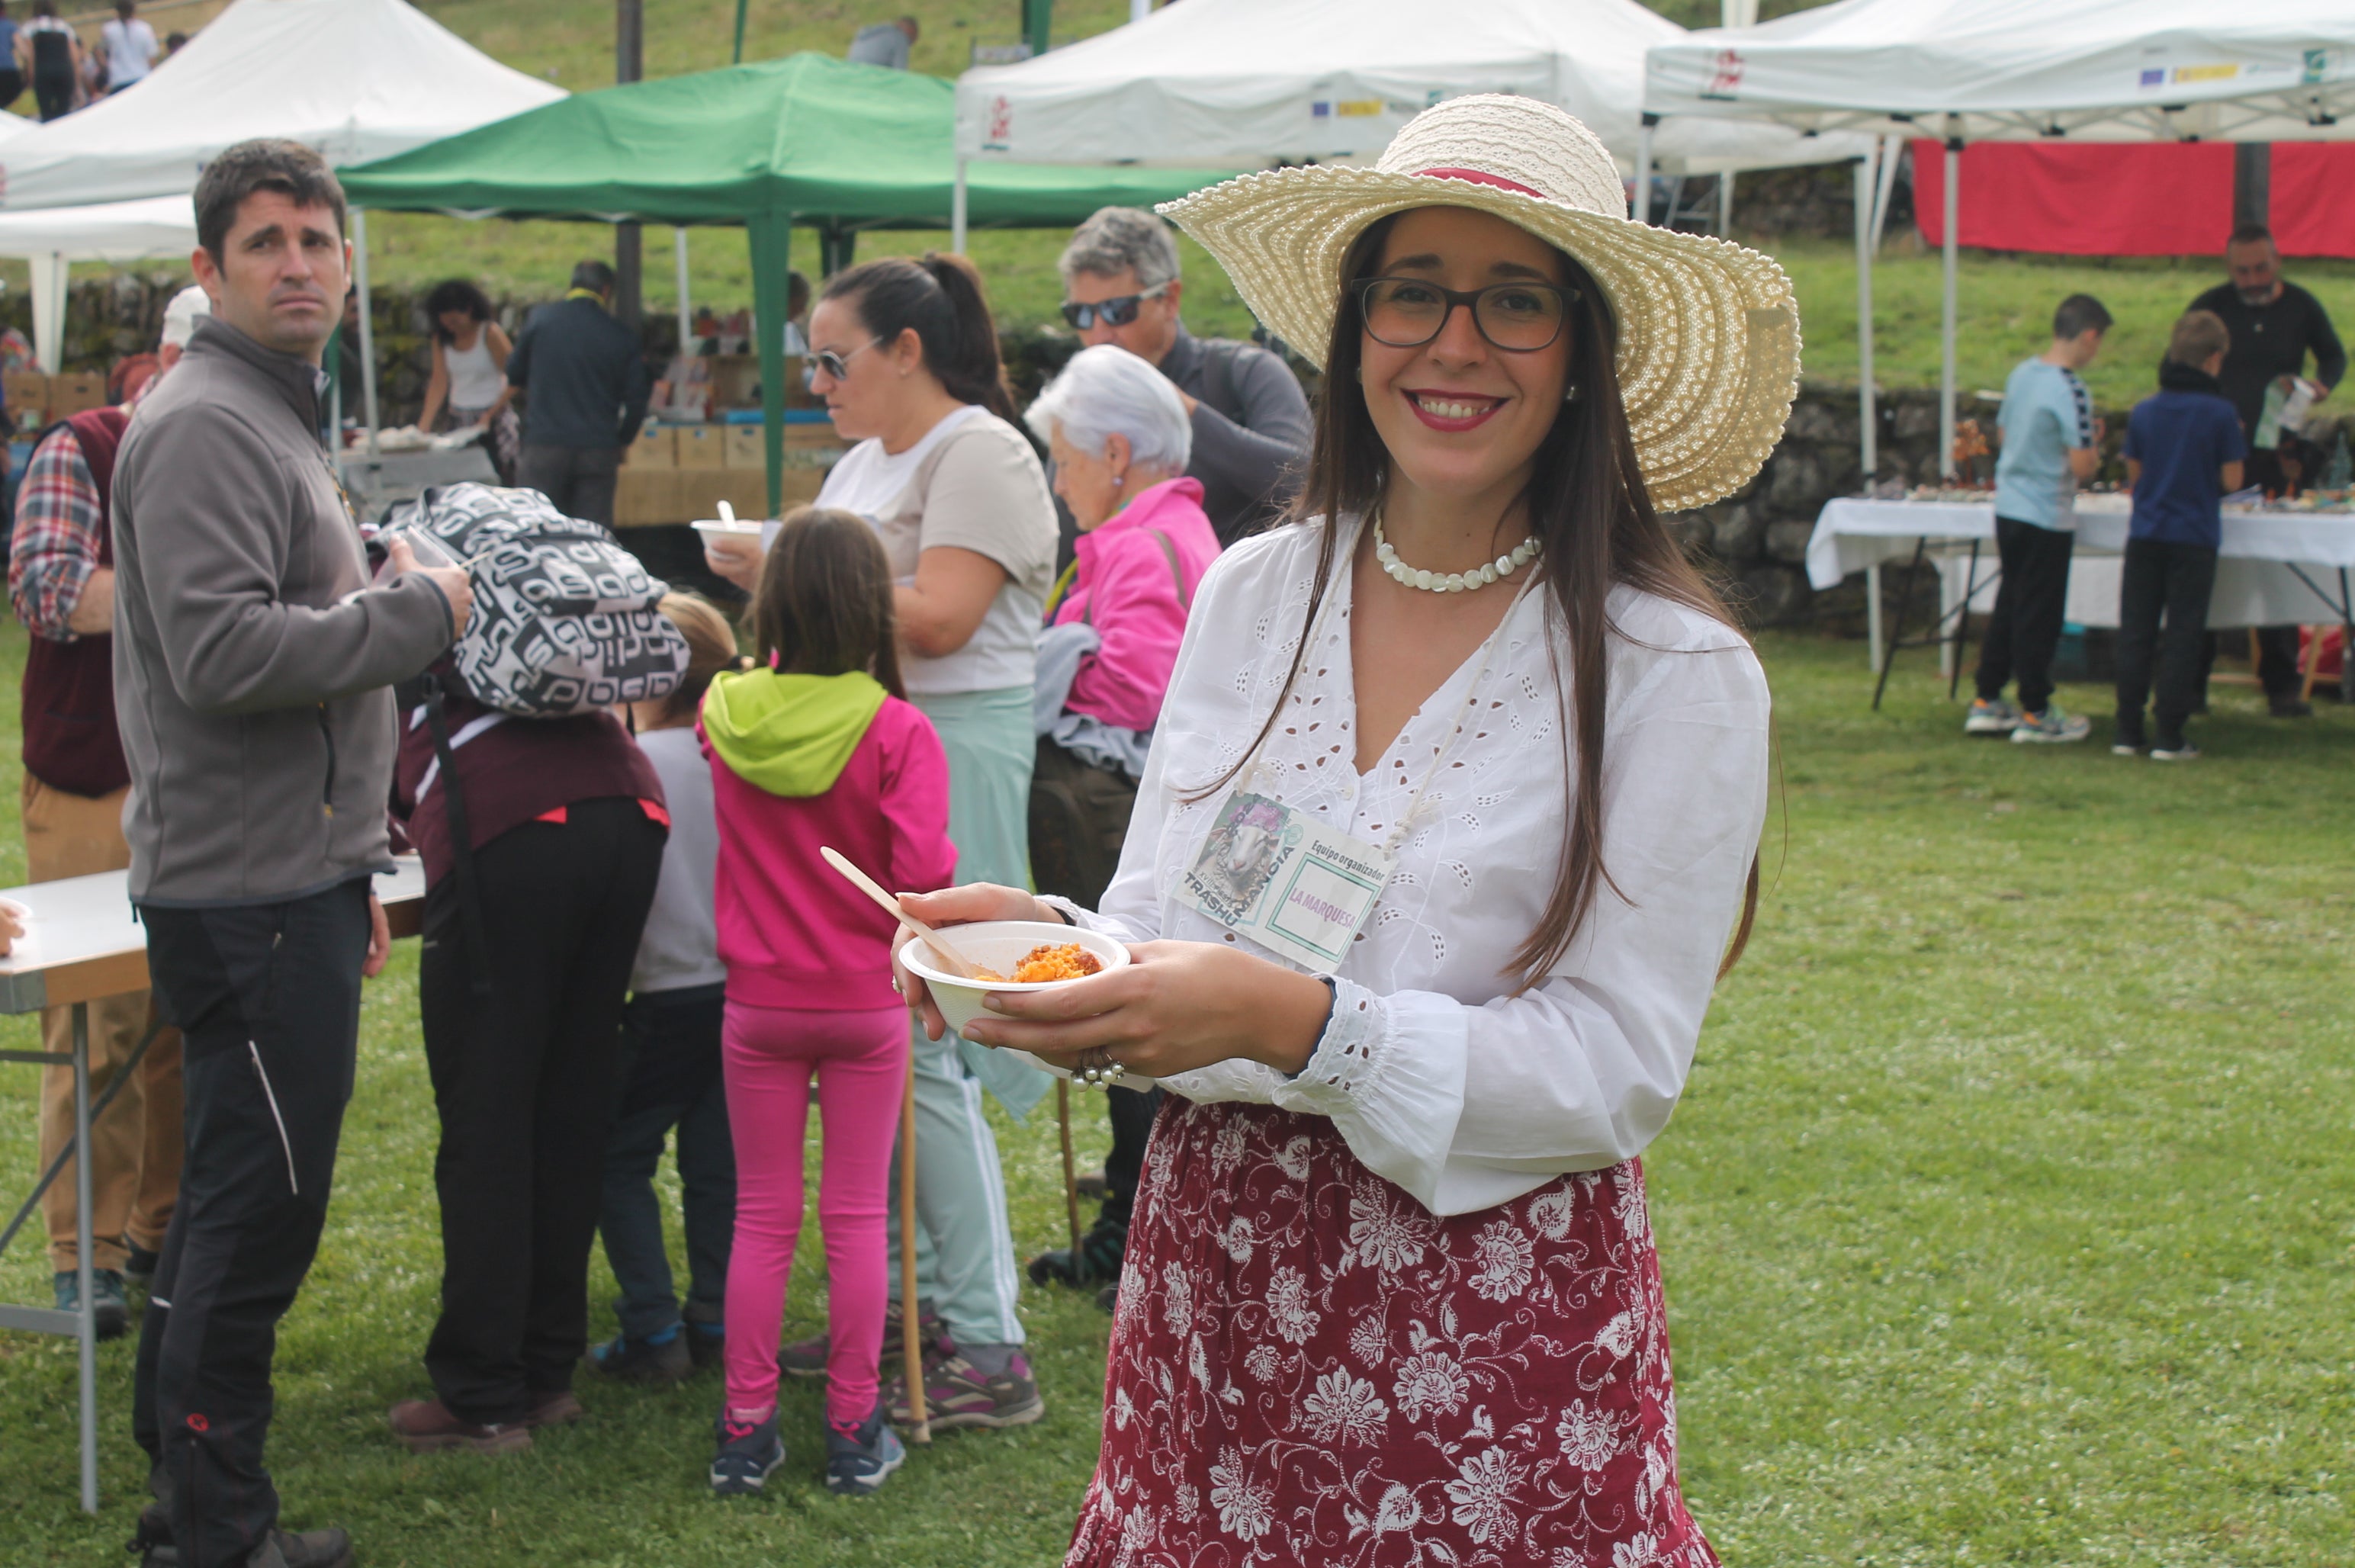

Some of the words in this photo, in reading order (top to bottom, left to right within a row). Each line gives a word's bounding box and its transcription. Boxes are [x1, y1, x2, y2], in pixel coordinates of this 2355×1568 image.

[1311, 840, 1340, 860] Equipo
[1338, 854, 1385, 881] organizador
[1288, 887, 1305, 904] LA
[1301, 893, 1356, 929] MARQUESA
